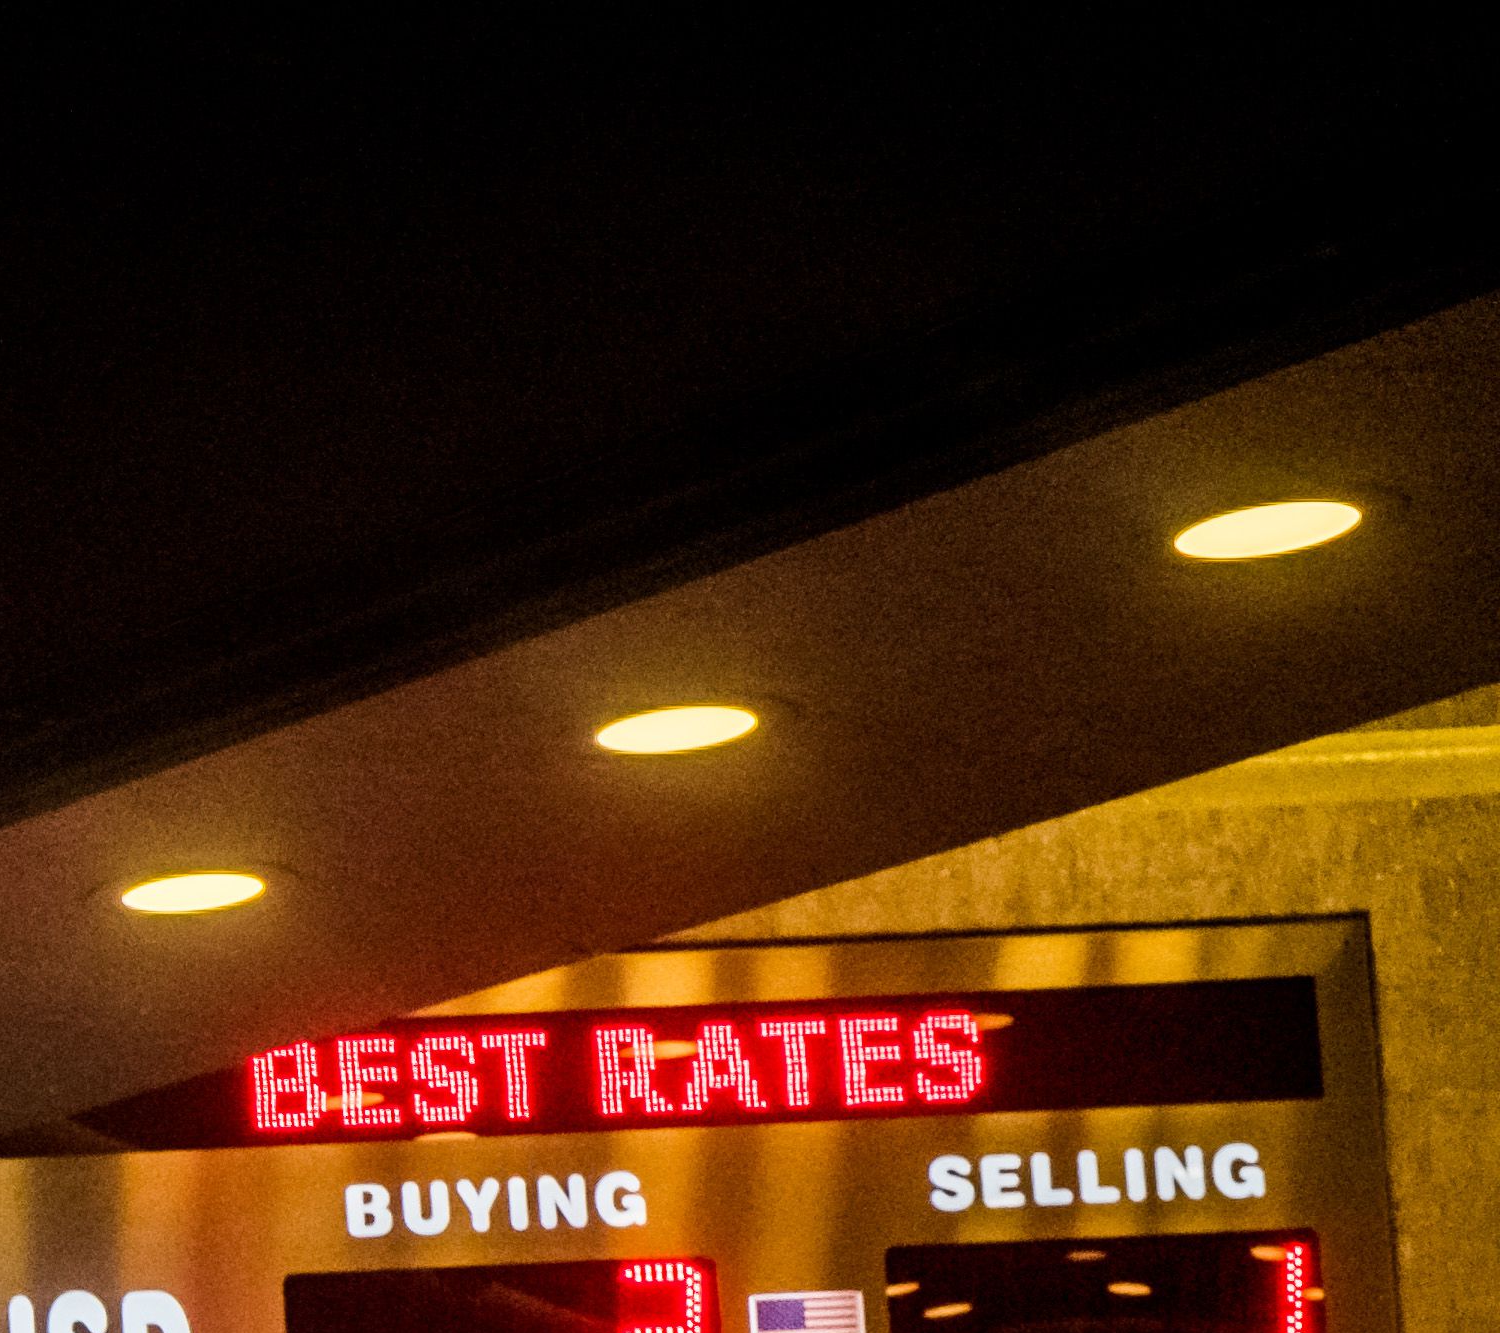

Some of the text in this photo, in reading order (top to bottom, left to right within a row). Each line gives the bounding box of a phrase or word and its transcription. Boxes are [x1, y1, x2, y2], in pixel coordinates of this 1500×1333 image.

[247, 1010, 986, 1136] BEST RATES
[344, 1170, 648, 1239] BUYING
[927, 1141, 1267, 1213] SELLING
